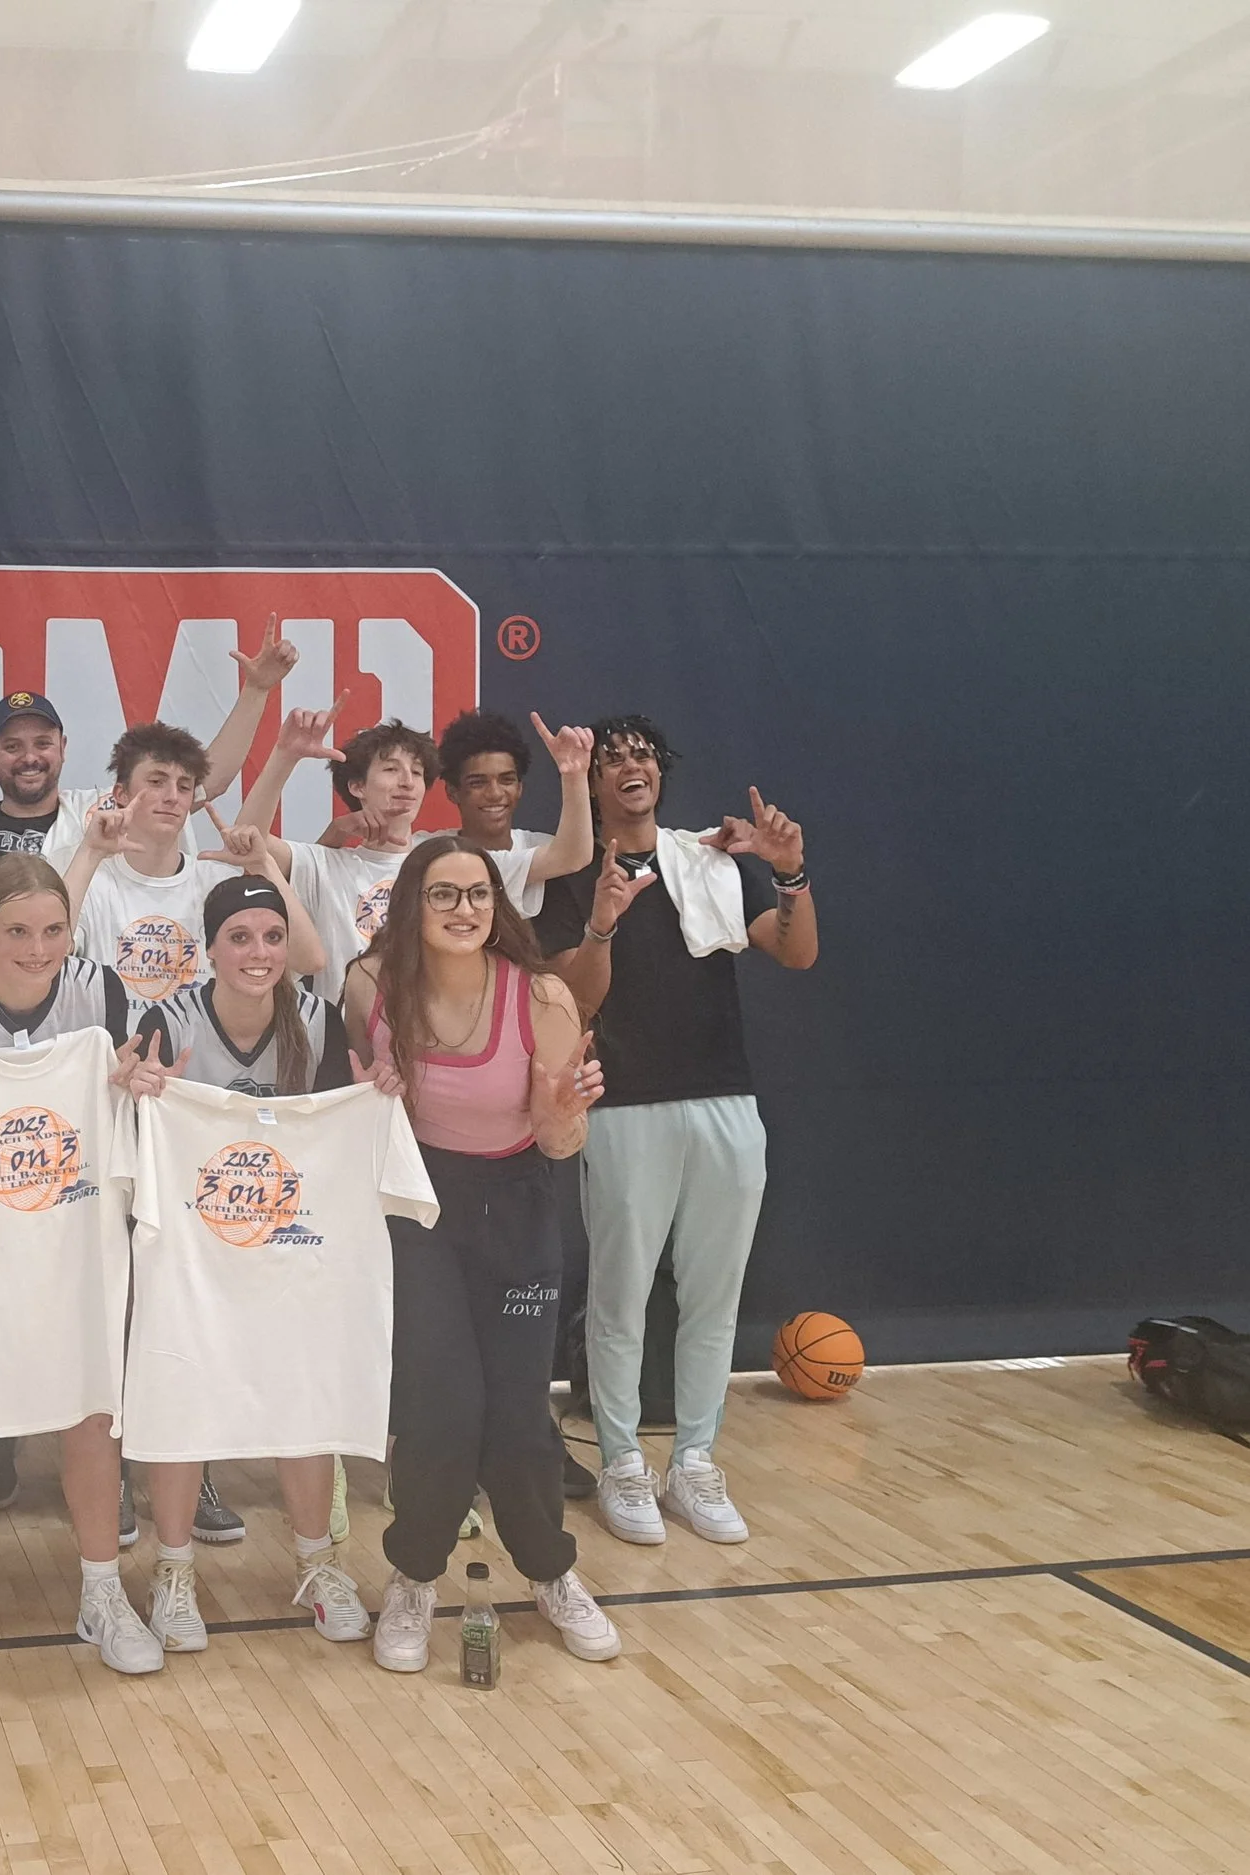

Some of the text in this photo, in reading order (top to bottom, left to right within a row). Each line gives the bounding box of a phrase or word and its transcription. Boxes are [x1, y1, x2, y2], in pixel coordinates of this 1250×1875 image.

[135, 924, 174, 940] 2025
[117, 942, 196, 967] 3 on 3
[0, 1115, 48, 1136] 2025
[25, 1129, 81, 1141] MADNESS
[11, 1149, 50, 1172] on
[58, 1136, 77, 1167] 3
[223, 1152, 273, 1171] 2025
[20, 1162, 90, 1179] BASKETBALL
[197, 1167, 304, 1179] MARCH MADNESS
[11, 1176, 61, 1188] LEAGUE
[197, 1175, 299, 1207] 3 on 3
[184, 1201, 313, 1216] YOUTH BASKETBALL
[224, 1214, 275, 1222] LEAGUE
[502, 1303, 543, 1317] LOVE
